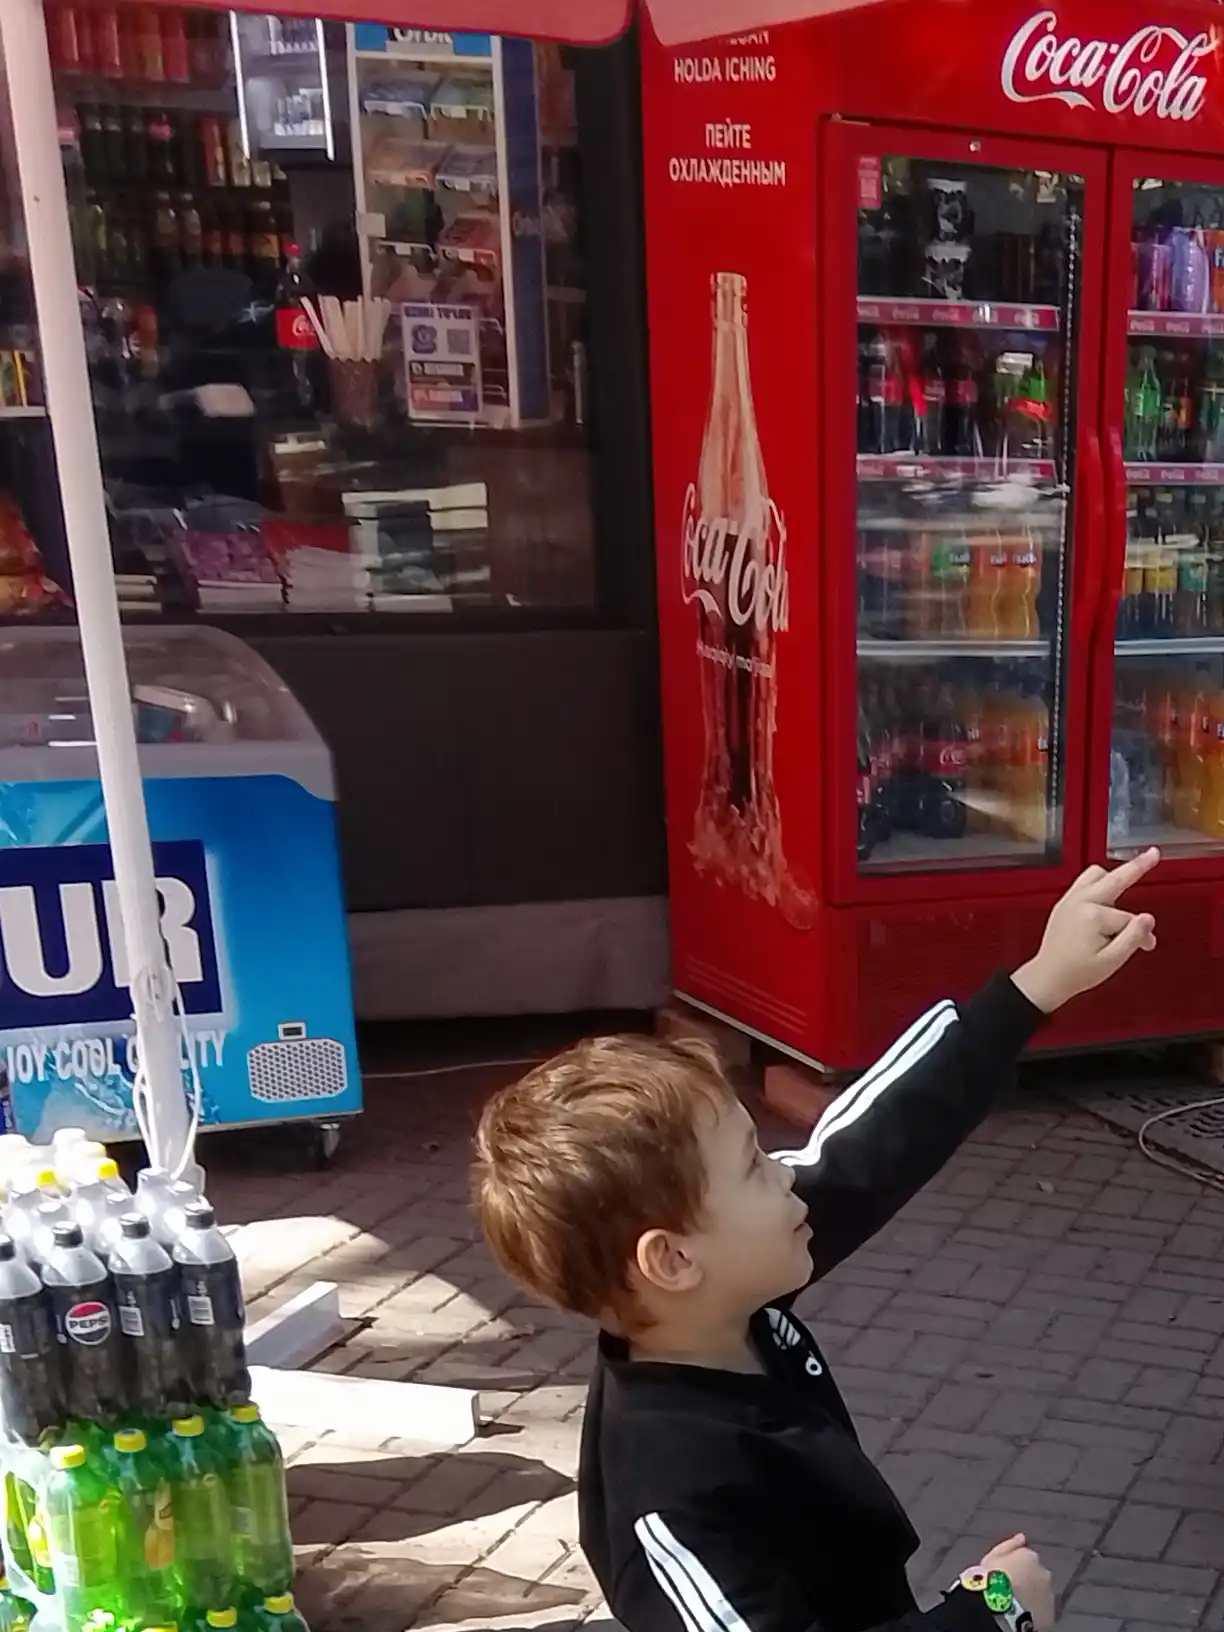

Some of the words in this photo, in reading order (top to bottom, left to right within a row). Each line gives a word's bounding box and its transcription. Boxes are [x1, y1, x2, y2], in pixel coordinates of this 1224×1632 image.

[674, 57, 722, 83] HOLDA
[726, 55, 776, 82] ICHING
[1001, 10, 1221, 120] Coca-Cola
[705, 117, 751, 149] ПЕЙТЕ
[669, 157, 786, 188] ОХЛАЖДЕННЫМ
[55, 1037, 122, 1081] COOL
[69, 1315, 109, 1329] PEPS
